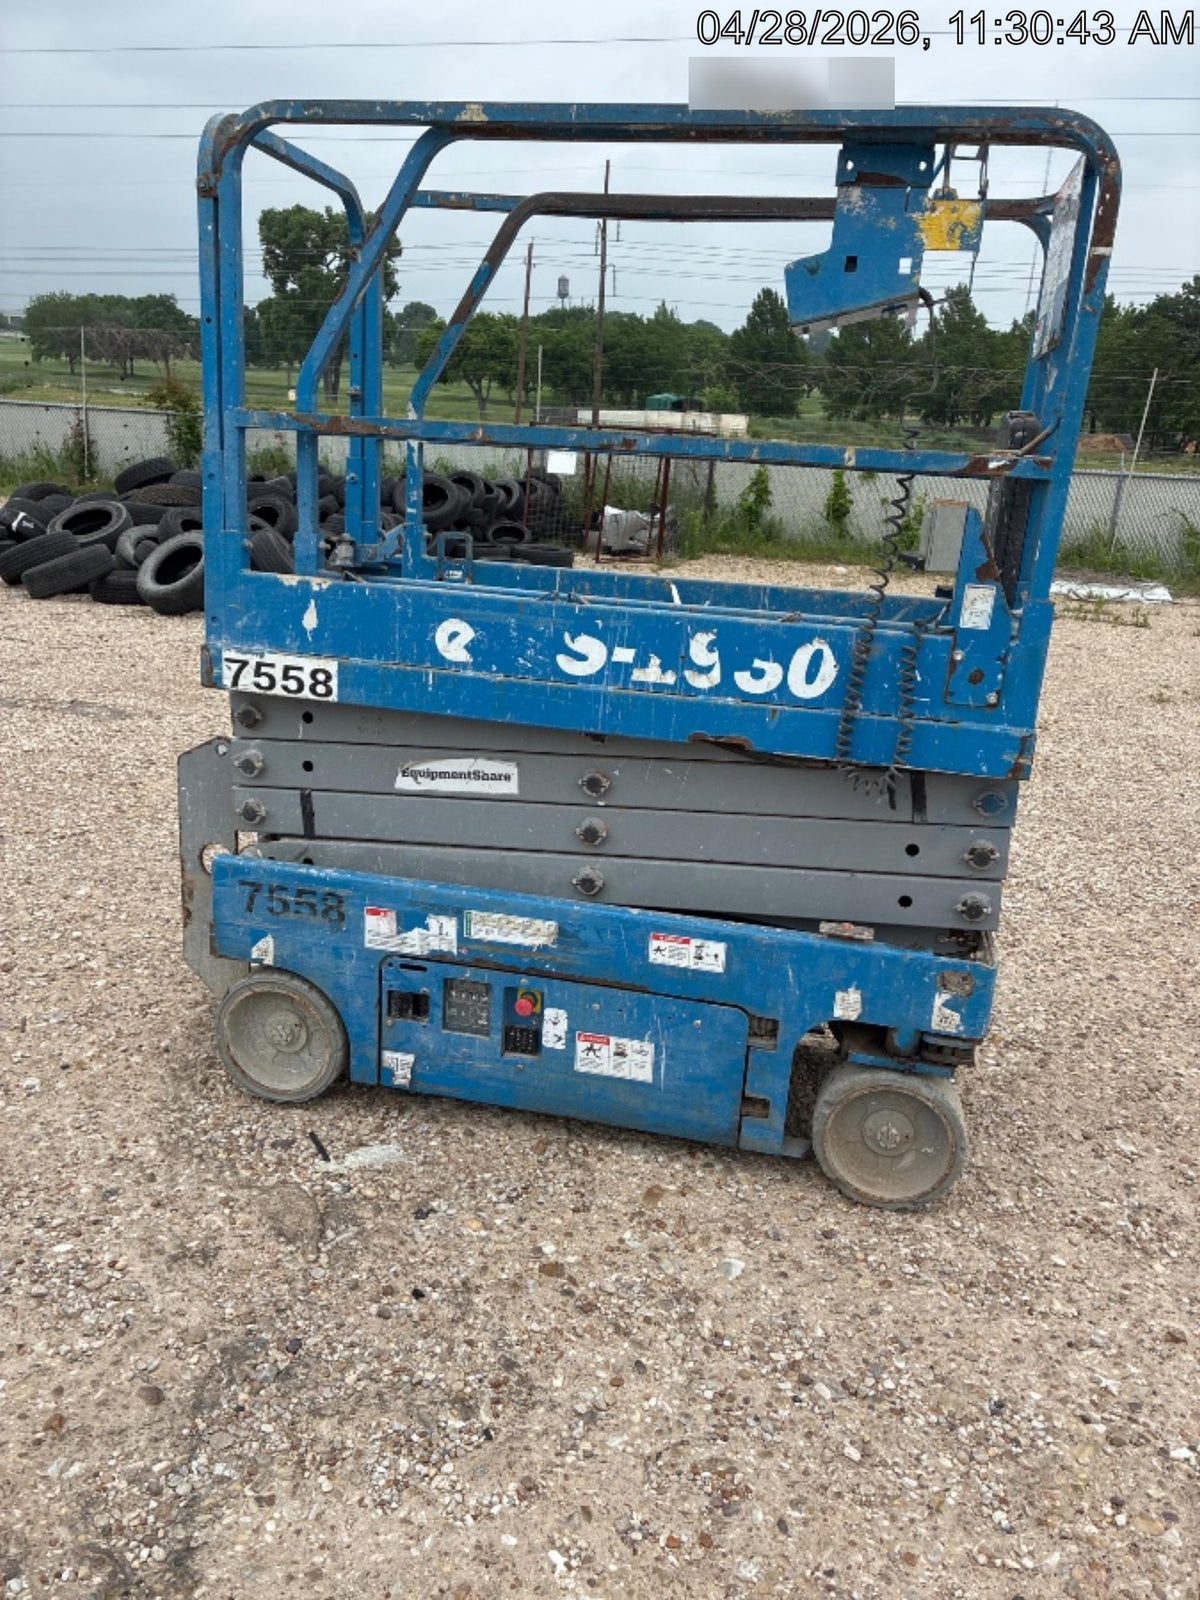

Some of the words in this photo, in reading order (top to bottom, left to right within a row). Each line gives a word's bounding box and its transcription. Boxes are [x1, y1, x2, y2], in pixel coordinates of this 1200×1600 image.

[223, 657, 334, 698] 7558
[400, 767, 513, 784] EquipmentShare
[238, 879, 346, 925] 7558
